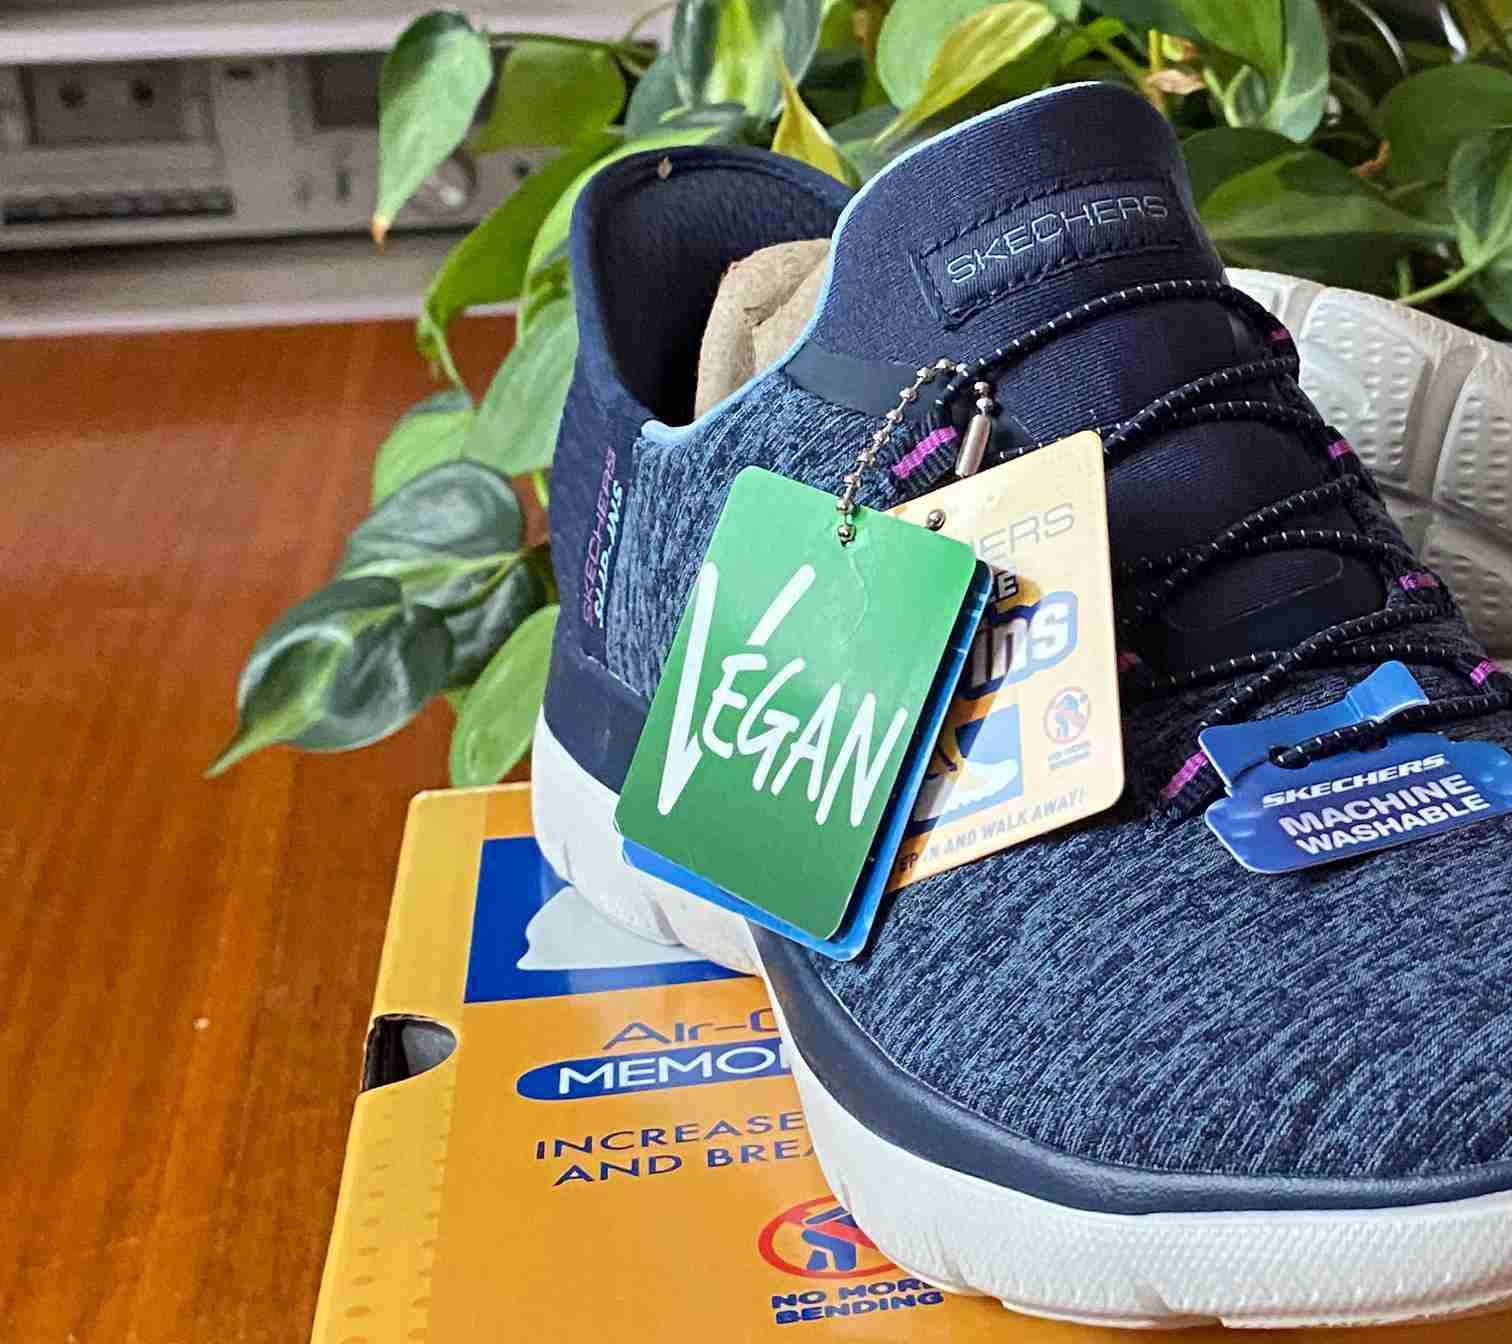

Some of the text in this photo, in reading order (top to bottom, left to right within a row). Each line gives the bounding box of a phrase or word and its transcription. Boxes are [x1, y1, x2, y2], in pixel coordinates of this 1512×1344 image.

[946, 195, 1169, 284] SKECHERS
[583, 444, 616, 627] SKECHERS
[656, 560, 909, 828] VEGAN
[1262, 753, 1446, 808] SKECHERS
[1278, 773, 1475, 838] MACHINE
[943, 829, 978, 854] AND
[982, 810, 1028, 839] WALK
[1295, 793, 1492, 856] WASHABLE
[552, 1138, 815, 1187] AND BRE
[770, 1291, 827, 1309] NO
[775, 1290, 945, 1325] BENDING
